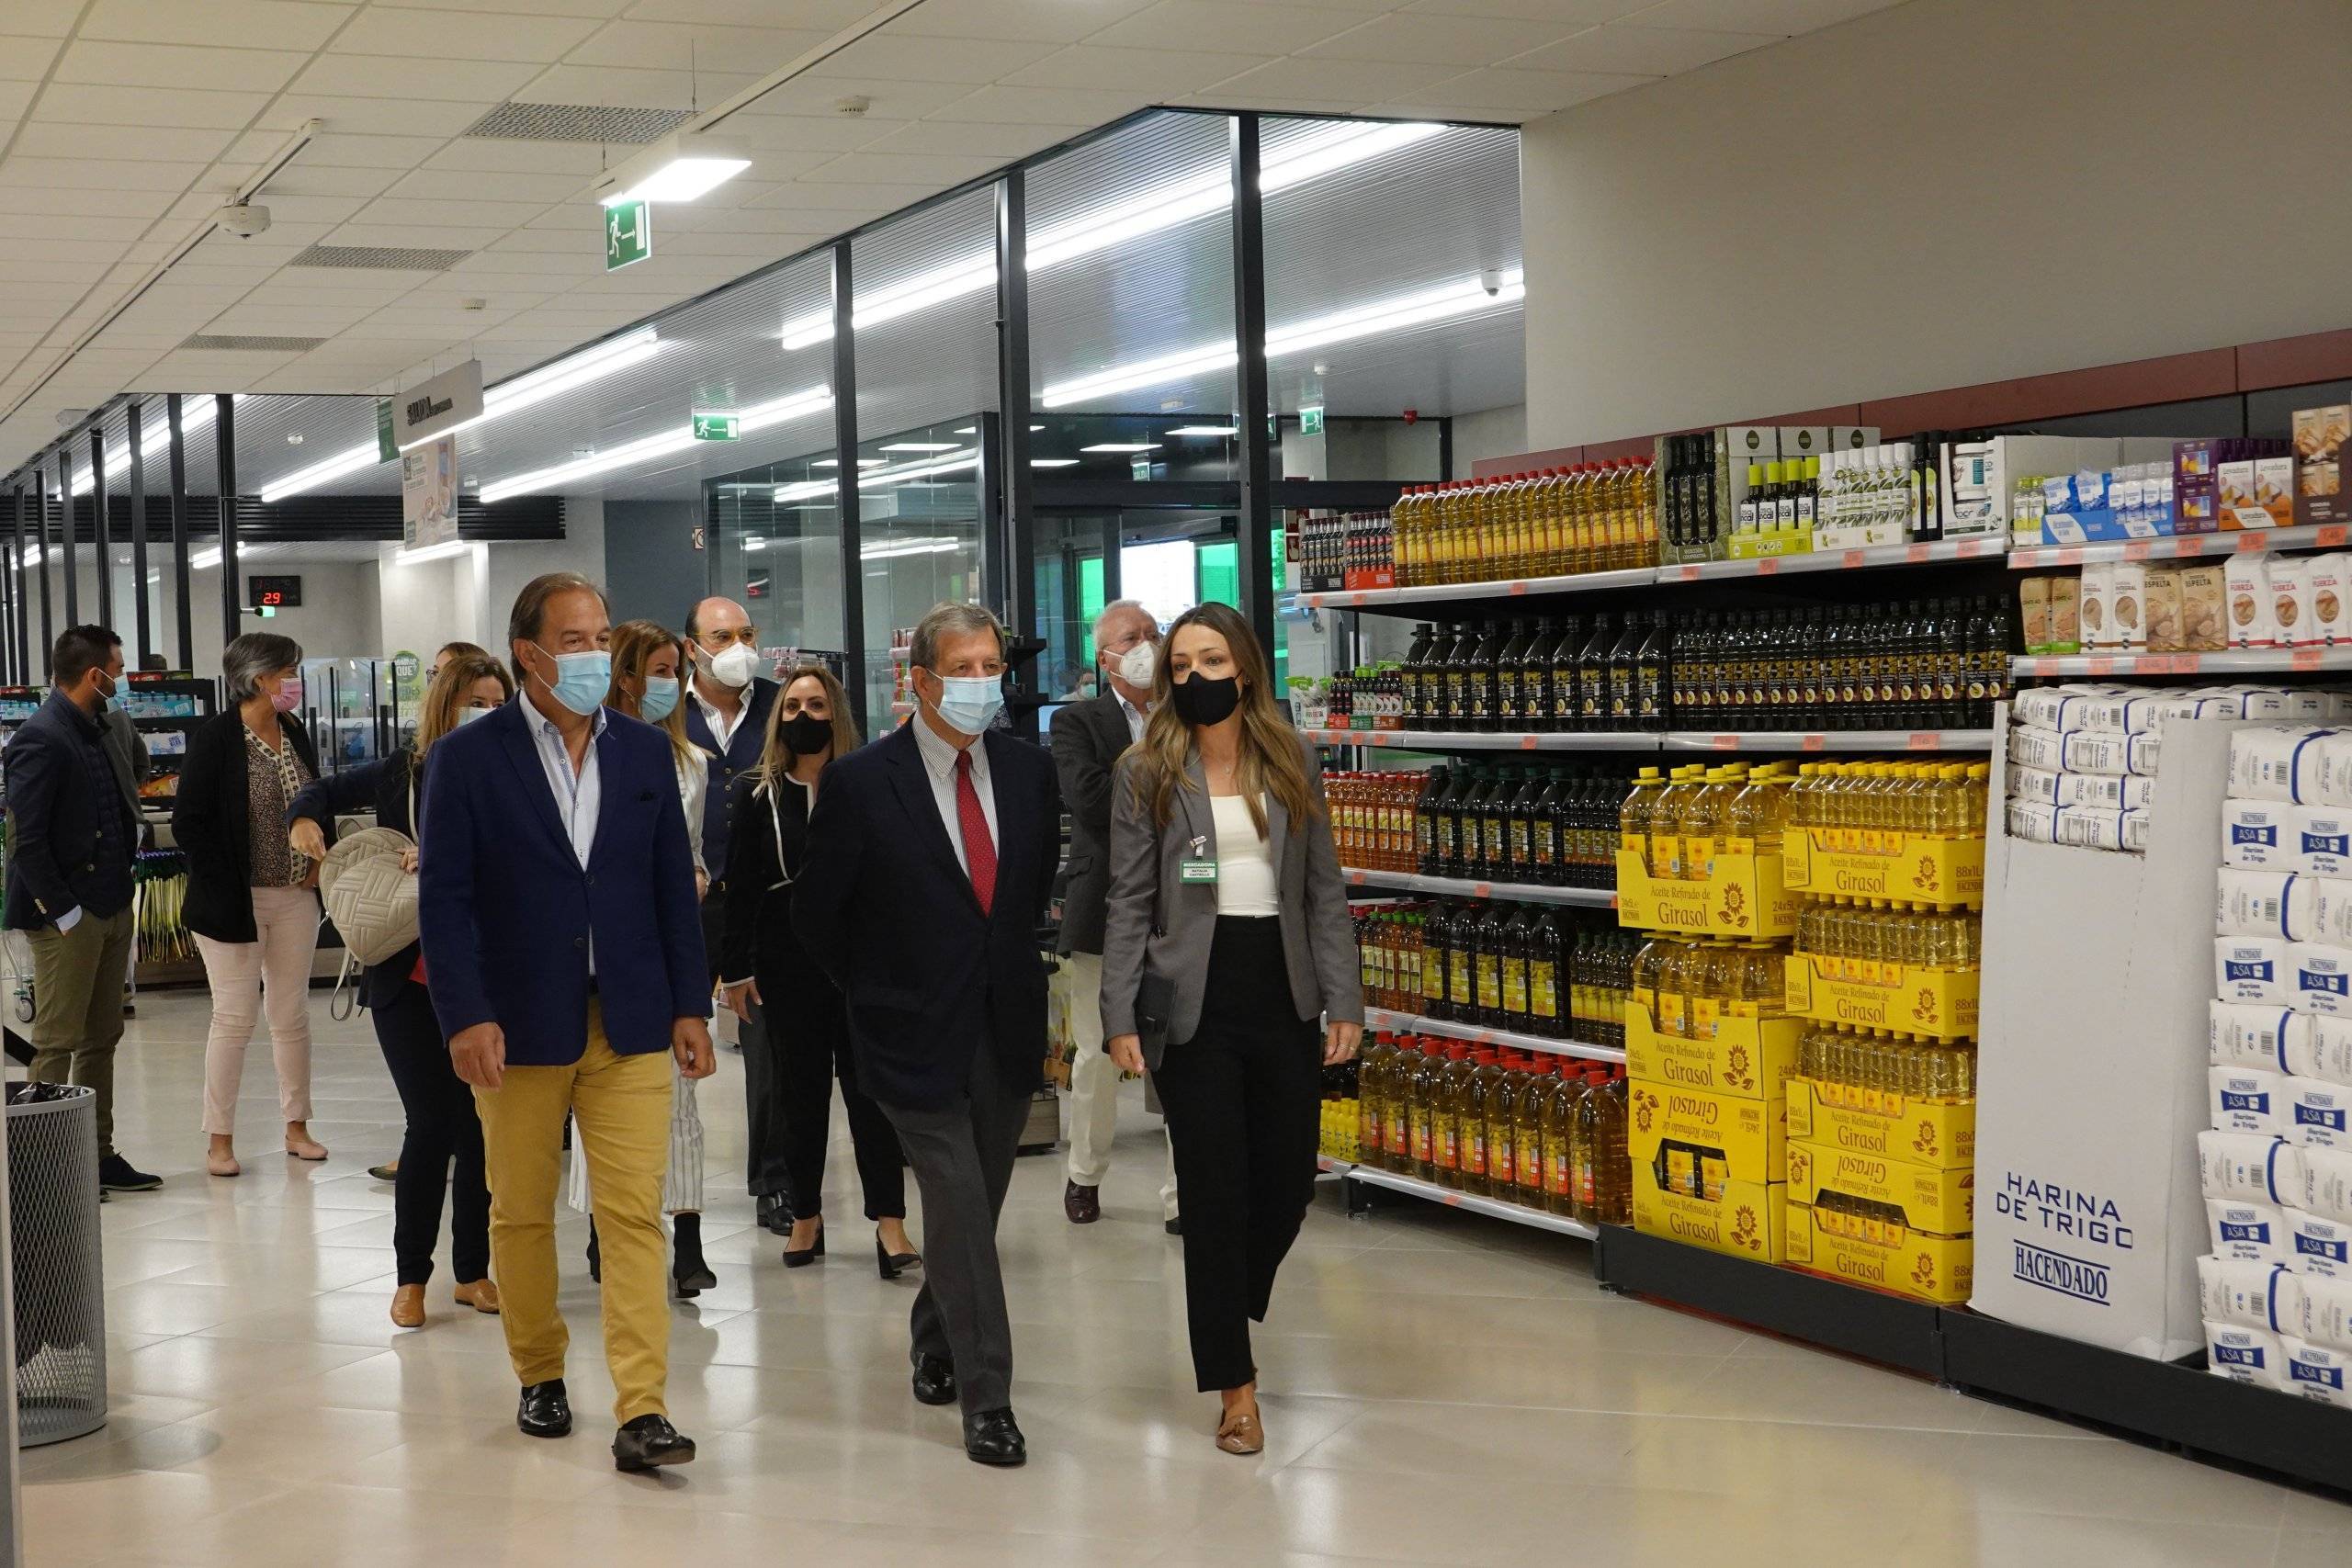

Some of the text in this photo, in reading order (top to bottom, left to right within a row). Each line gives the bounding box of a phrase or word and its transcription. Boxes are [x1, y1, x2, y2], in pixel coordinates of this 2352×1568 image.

[2238, 829, 2256, 840] ASA
[2309, 838, 2326, 849] ASA
[1829, 857, 1849, 867] Aceite
[1882, 860, 1891, 871] de
[1955, 865, 1982, 878] 88x1L
[1836, 870, 1885, 894] Girasol
[1650, 886, 1668, 898] Aceite
[1702, 887, 1711, 900] de
[1657, 902, 1709, 927] Girasol
[2233, 964, 2251, 976] ASA
[2307, 976, 2325, 988] ASA
[1830, 985, 1849, 996] Aceite
[1880, 989, 1889, 1001] de
[1837, 998, 1885, 1023] Girasol
[1656, 1040, 1675, 1055] Aceite
[1707, 1047, 1716, 1060] de
[1663, 1058, 1714, 1088] Girasol
[1668, 1095, 1718, 1125] Girasol
[2228, 1095, 2246, 1108] ASA
[1830, 1111, 1850, 1123] Aceite
[1883, 1119, 1891, 1132] de
[2302, 1110, 2322, 1122] ASA
[1838, 1126, 1887, 1153] Girasol
[1838, 1156, 1887, 1184] Girasol
[2007, 1171, 2121, 1223] HARINA
[1661, 1196, 1679, 1210] Aceite
[1713, 1207, 1722, 1220] de
[1668, 1213, 1721, 1244] Girasol
[1996, 1192, 2133, 1249] DE TRIGO
[2227, 1226, 2245, 1238] ASA
[1829, 1238, 1849, 1252] Aceite
[1880, 1249, 1889, 1262] de
[2302, 1239, 2323, 1253] ASA
[1837, 1252, 1885, 1282] Girasol
[2015, 1246, 2108, 1299] HACENDADO
[2222, 1349, 2241, 1361] ASA
[2297, 1365, 2317, 1379] ASA
